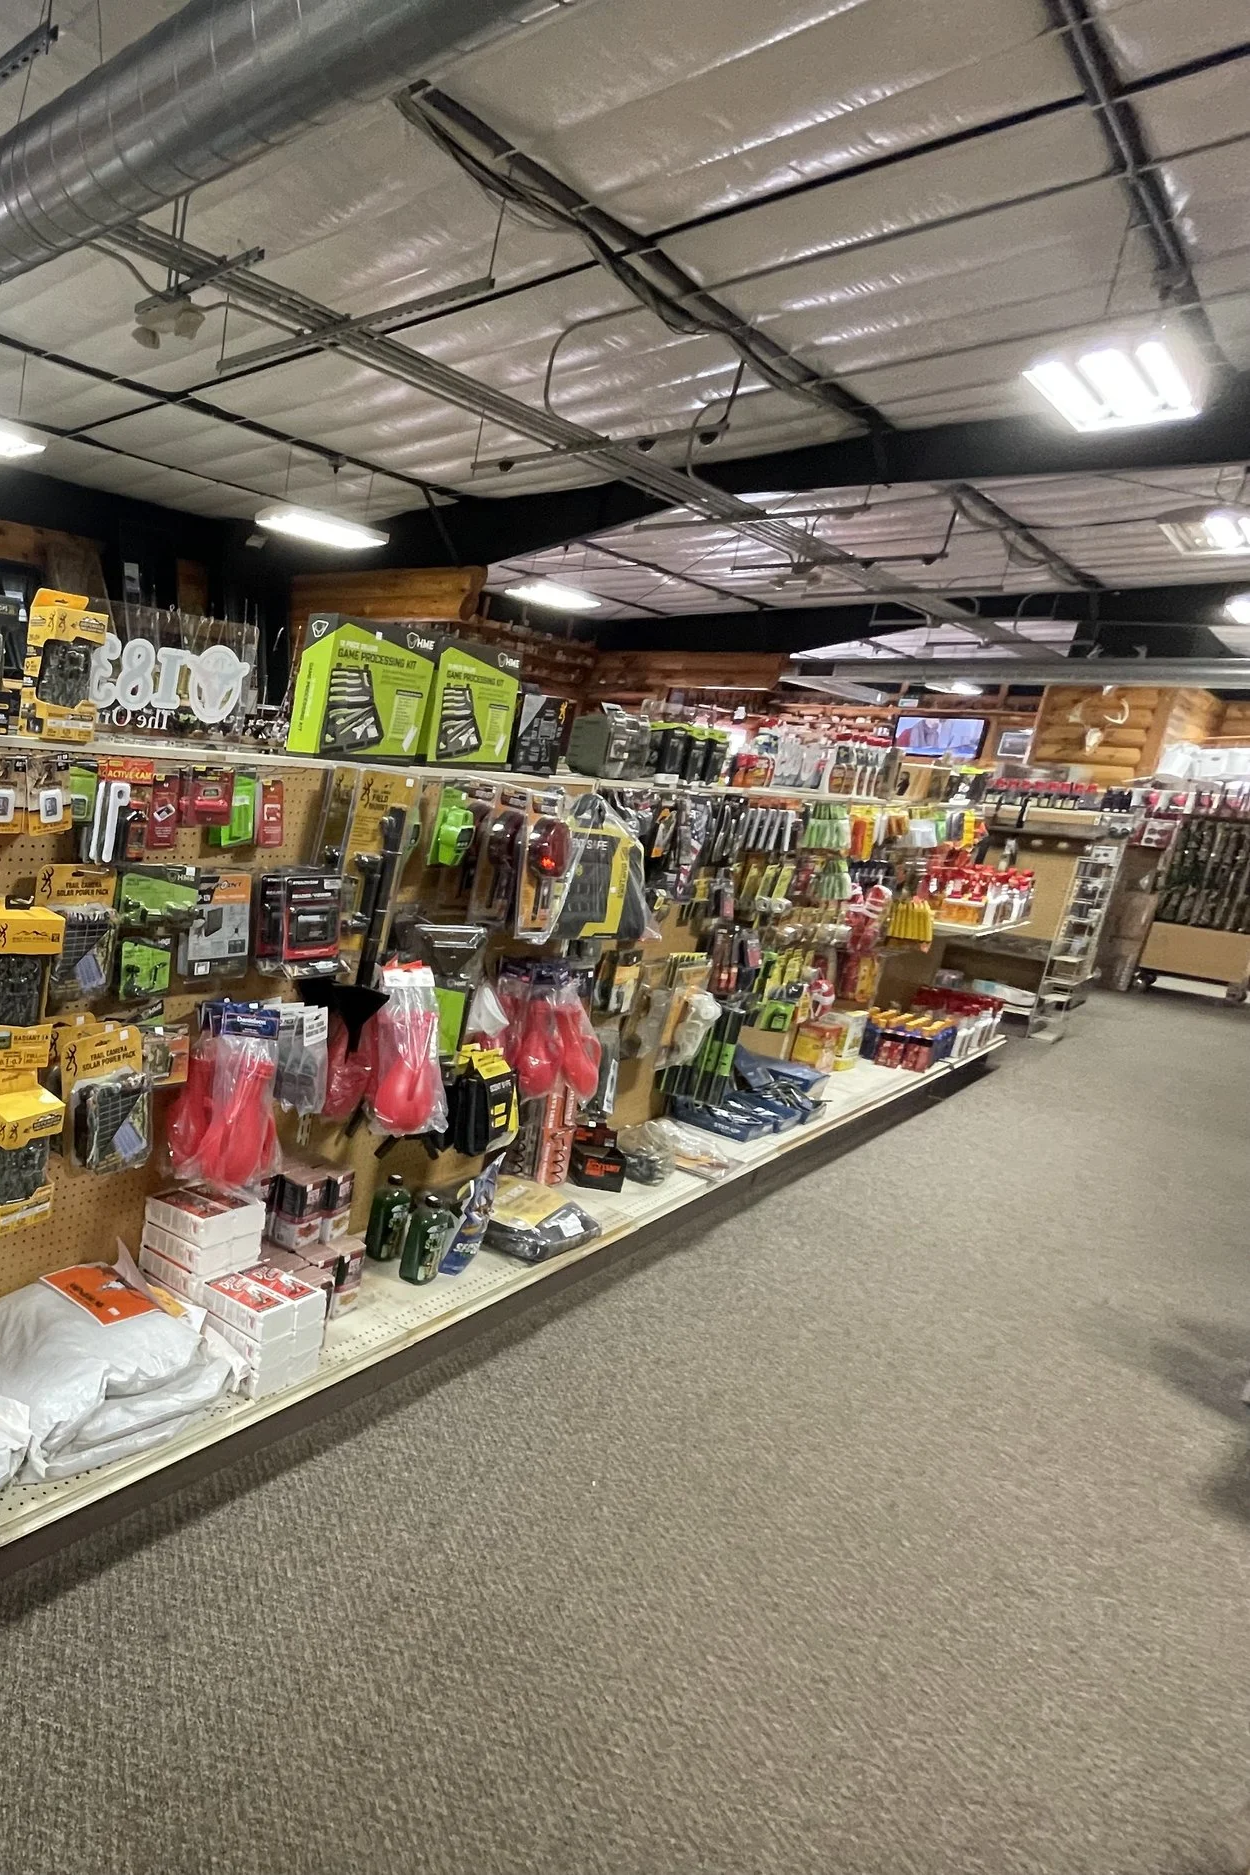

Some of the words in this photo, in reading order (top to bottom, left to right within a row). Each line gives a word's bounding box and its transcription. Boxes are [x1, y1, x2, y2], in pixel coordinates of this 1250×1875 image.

[417, 639, 435, 651] HME
[338, 648, 360, 660] GAME
[361, 650, 406, 668] PROCESSING
[406, 659, 417, 670] KIT
[505, 658, 520, 669] HME
[447, 670, 463, 682] GAME
[463, 672, 497, 686] PROCESSING
[496, 677, 504, 687] KIT
[66, 881, 80, 889] TRAIL
[81, 881, 102, 889] CAMERA
[56, 889, 74, 897] SOLAR
[75, 889, 94, 897] POWER
[95, 888, 109, 896] PACK
[91, 1051, 105, 1061] TRAIL
[106, 1046, 128, 1057] CAMERA
[82, 1059, 101, 1071] SOLAR
[101, 1055, 122, 1066] POWER
[122, 1050, 137, 1060] PACK
